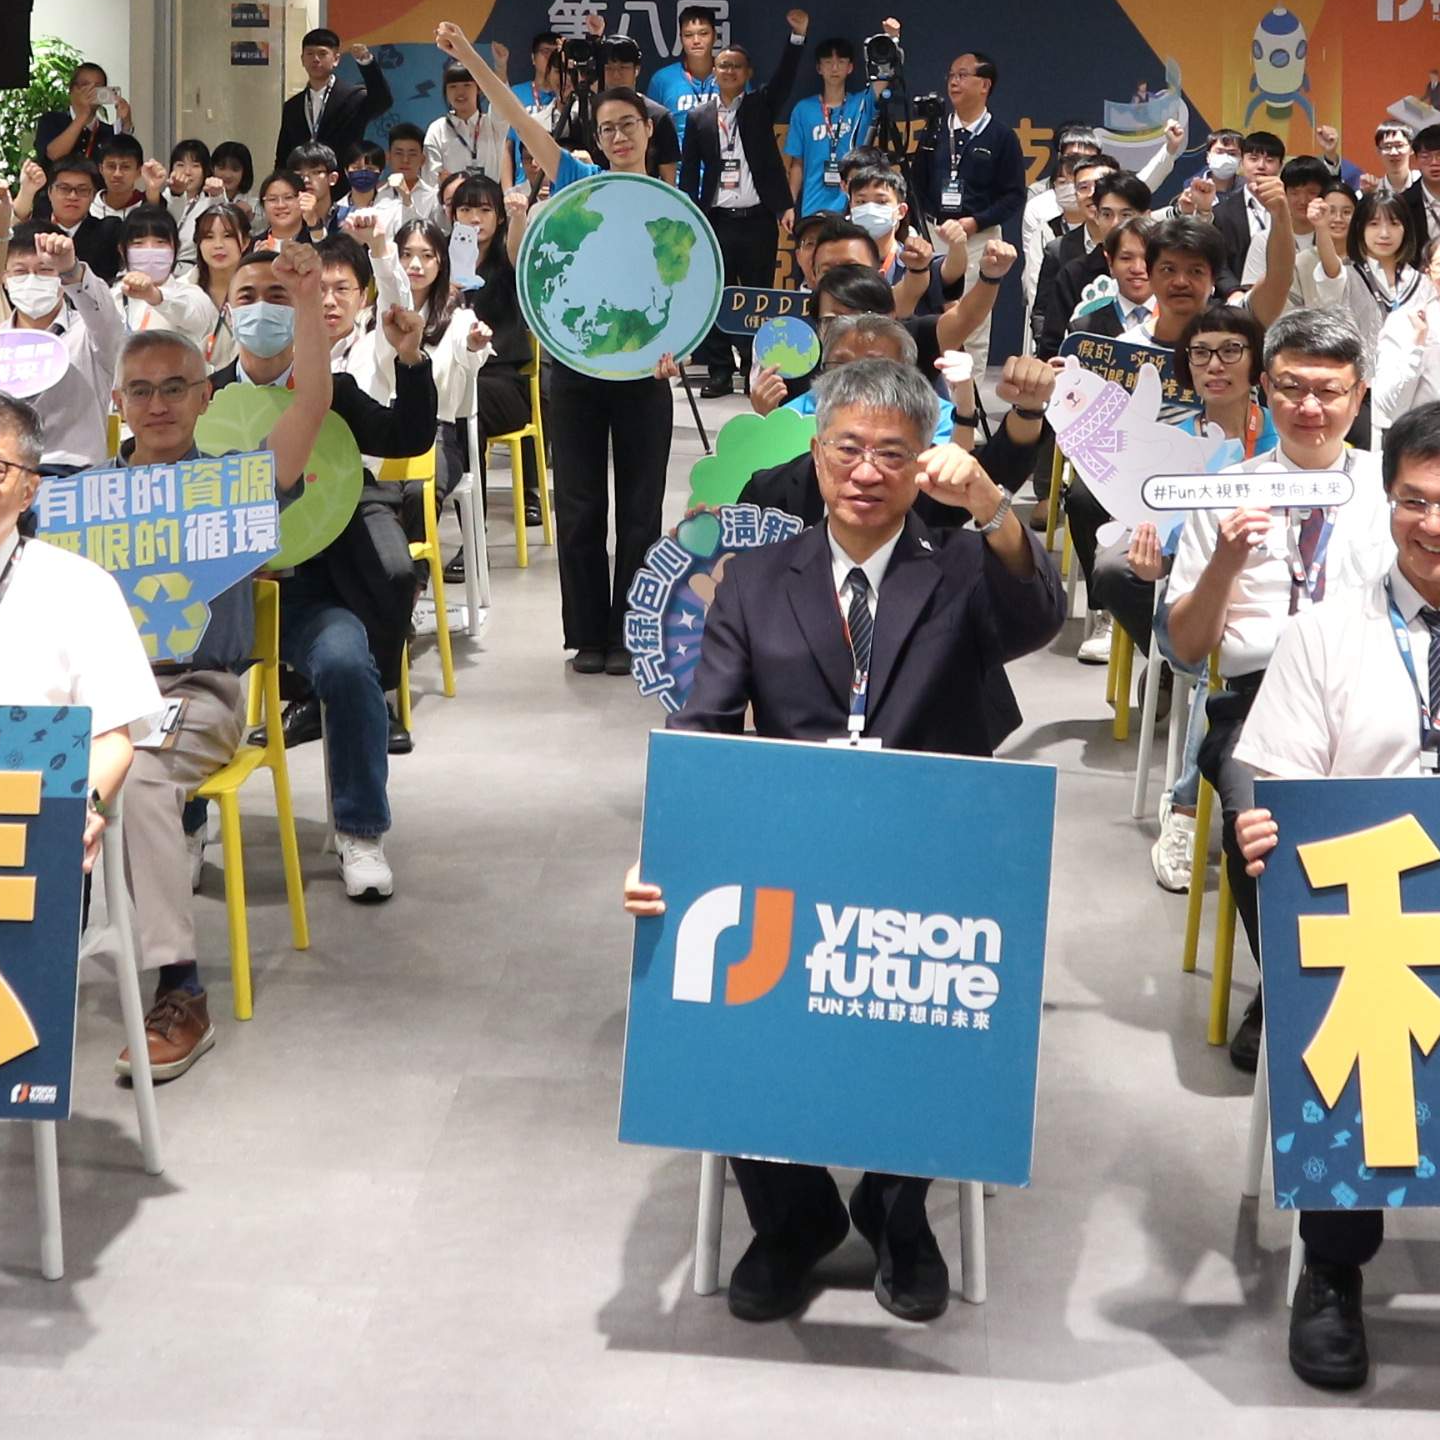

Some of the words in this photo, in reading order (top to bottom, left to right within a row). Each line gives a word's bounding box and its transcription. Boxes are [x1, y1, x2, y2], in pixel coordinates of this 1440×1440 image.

[35, 454, 274, 528] 有限的資源
[815, 903, 1001, 963] vision
[805, 941, 1000, 1010] future
